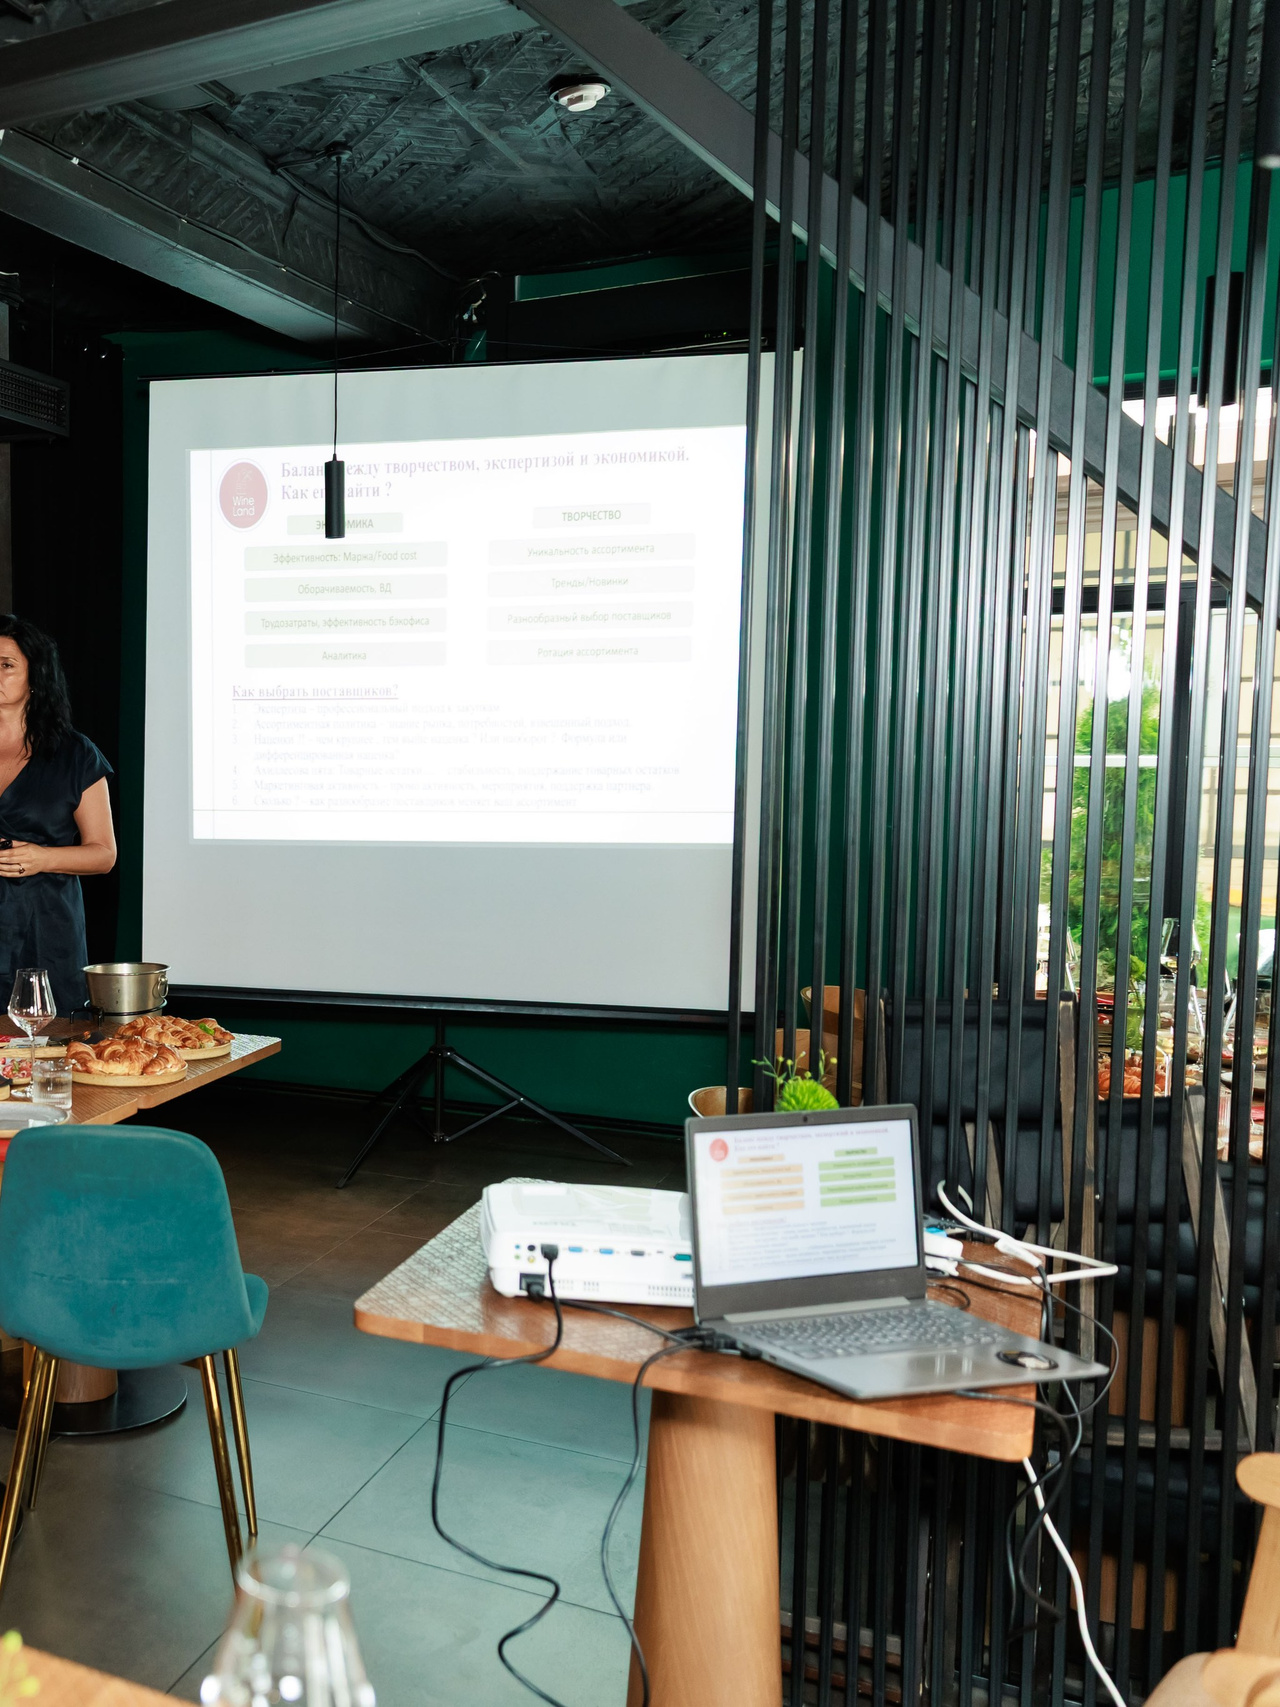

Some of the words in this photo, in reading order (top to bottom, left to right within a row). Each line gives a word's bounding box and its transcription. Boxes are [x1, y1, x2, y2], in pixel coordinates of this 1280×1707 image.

[281, 462, 325, 478] Балан
[345, 463, 381, 479] ежду
[385, 457, 479, 477] творчеством,
[484, 451, 574, 473] экспертизой
[580, 455, 588, 466] и
[593, 446, 689, 464] экономикой.
[281, 485, 308, 500] Как
[345, 482, 380, 498] айти
[232, 495, 254, 506] Wine
[233, 505, 255, 517] Land
[561, 509, 622, 522] ТВОРЧЕСТВО
[527, 546, 589, 558] Уникальность
[591, 543, 655, 556] ассортимента
[273, 553, 341, 565] Эффективность:
[400, 551, 418, 561] cost
[379, 583, 392, 594] ВД
[261, 618, 320, 629] Трудозатраты,
[322, 617, 387, 628] эффективность
[389, 615, 430, 628] бэкофиса
[507, 613, 578, 625] Разнообразный
[580, 611, 609, 623] выбор
[612, 610, 672, 623] поставщиков
[321, 650, 367, 661] Аналитика
[536, 647, 574, 659] Ротация
[576, 646, 639, 658] ассортимента
[232, 685, 255, 698] Как
[259, 685, 308, 699] выбрать
